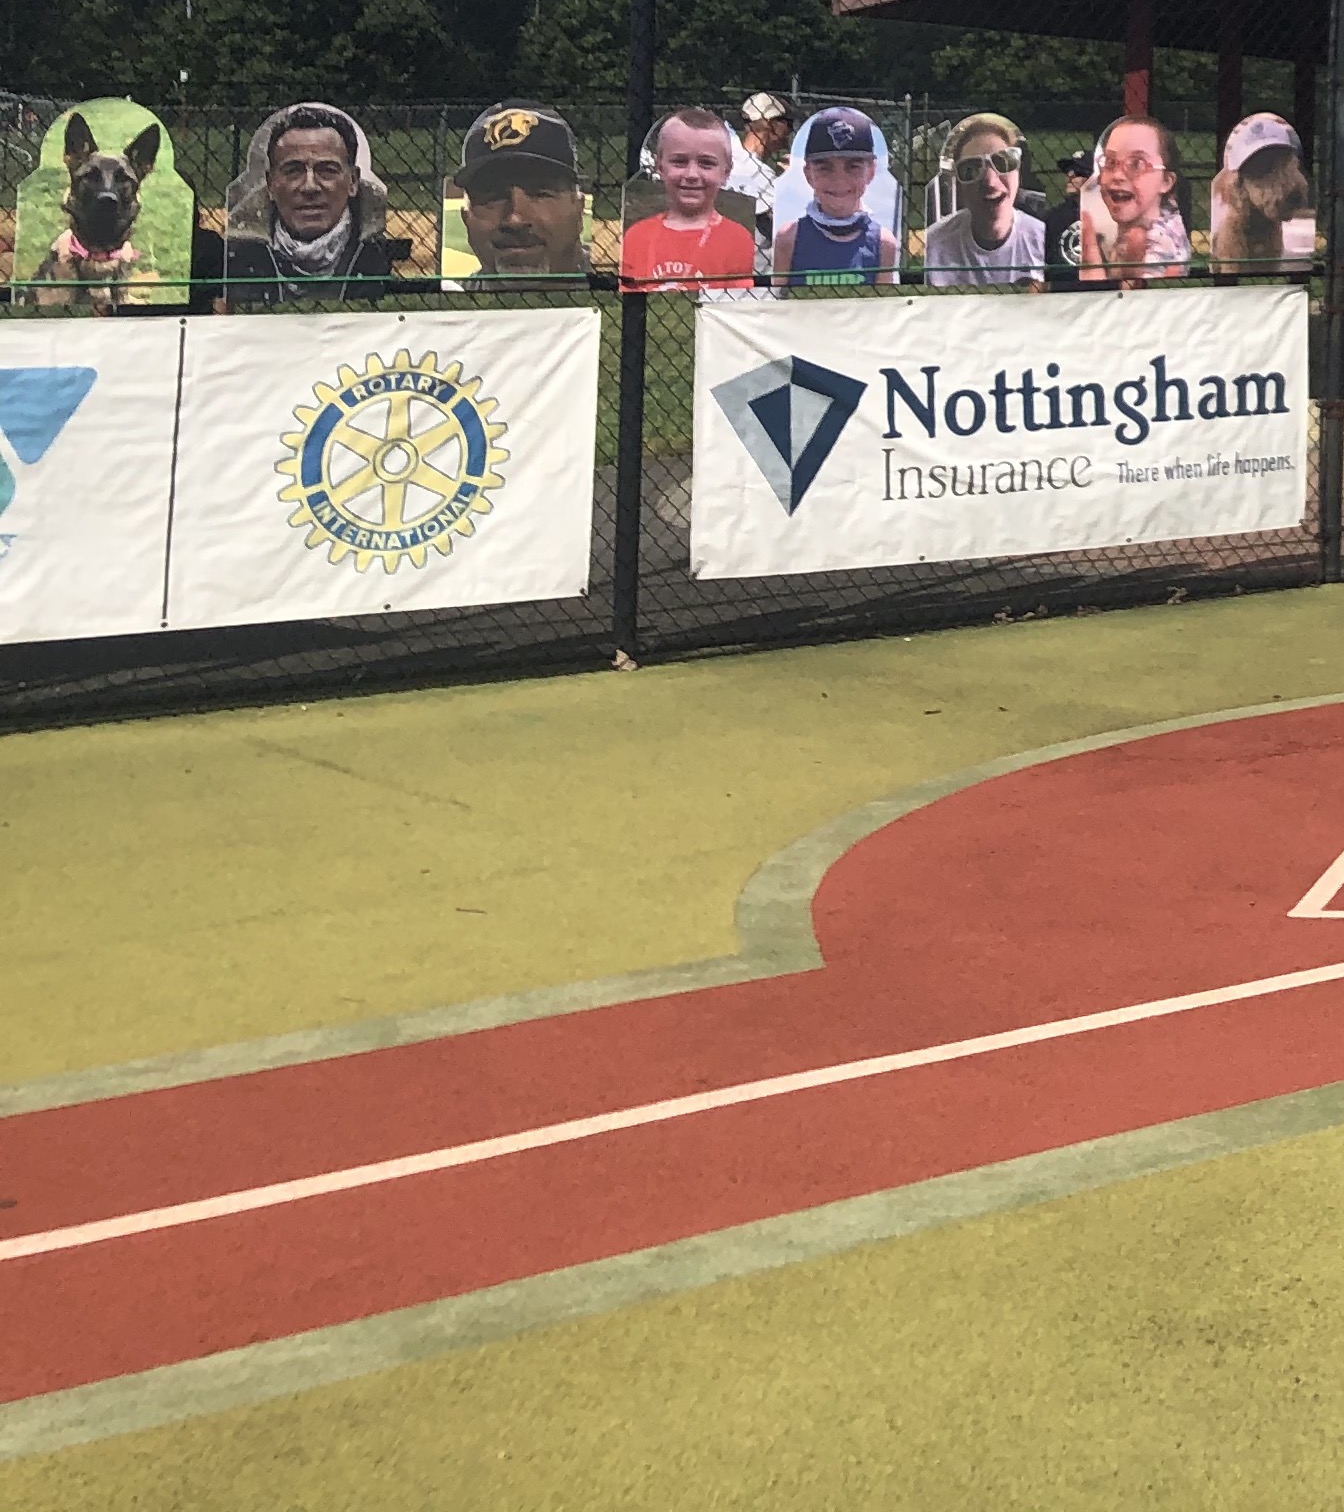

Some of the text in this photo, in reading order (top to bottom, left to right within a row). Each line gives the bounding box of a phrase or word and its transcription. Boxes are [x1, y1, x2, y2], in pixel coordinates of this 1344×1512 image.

[352, 373, 449, 402] ROTARY
[879, 354, 1291, 445] Nottingham
[881, 448, 1094, 502] Insurance
[1116, 451, 1296, 484] There when life happens.
[312, 490, 477, 550] INTERNATIONAL
